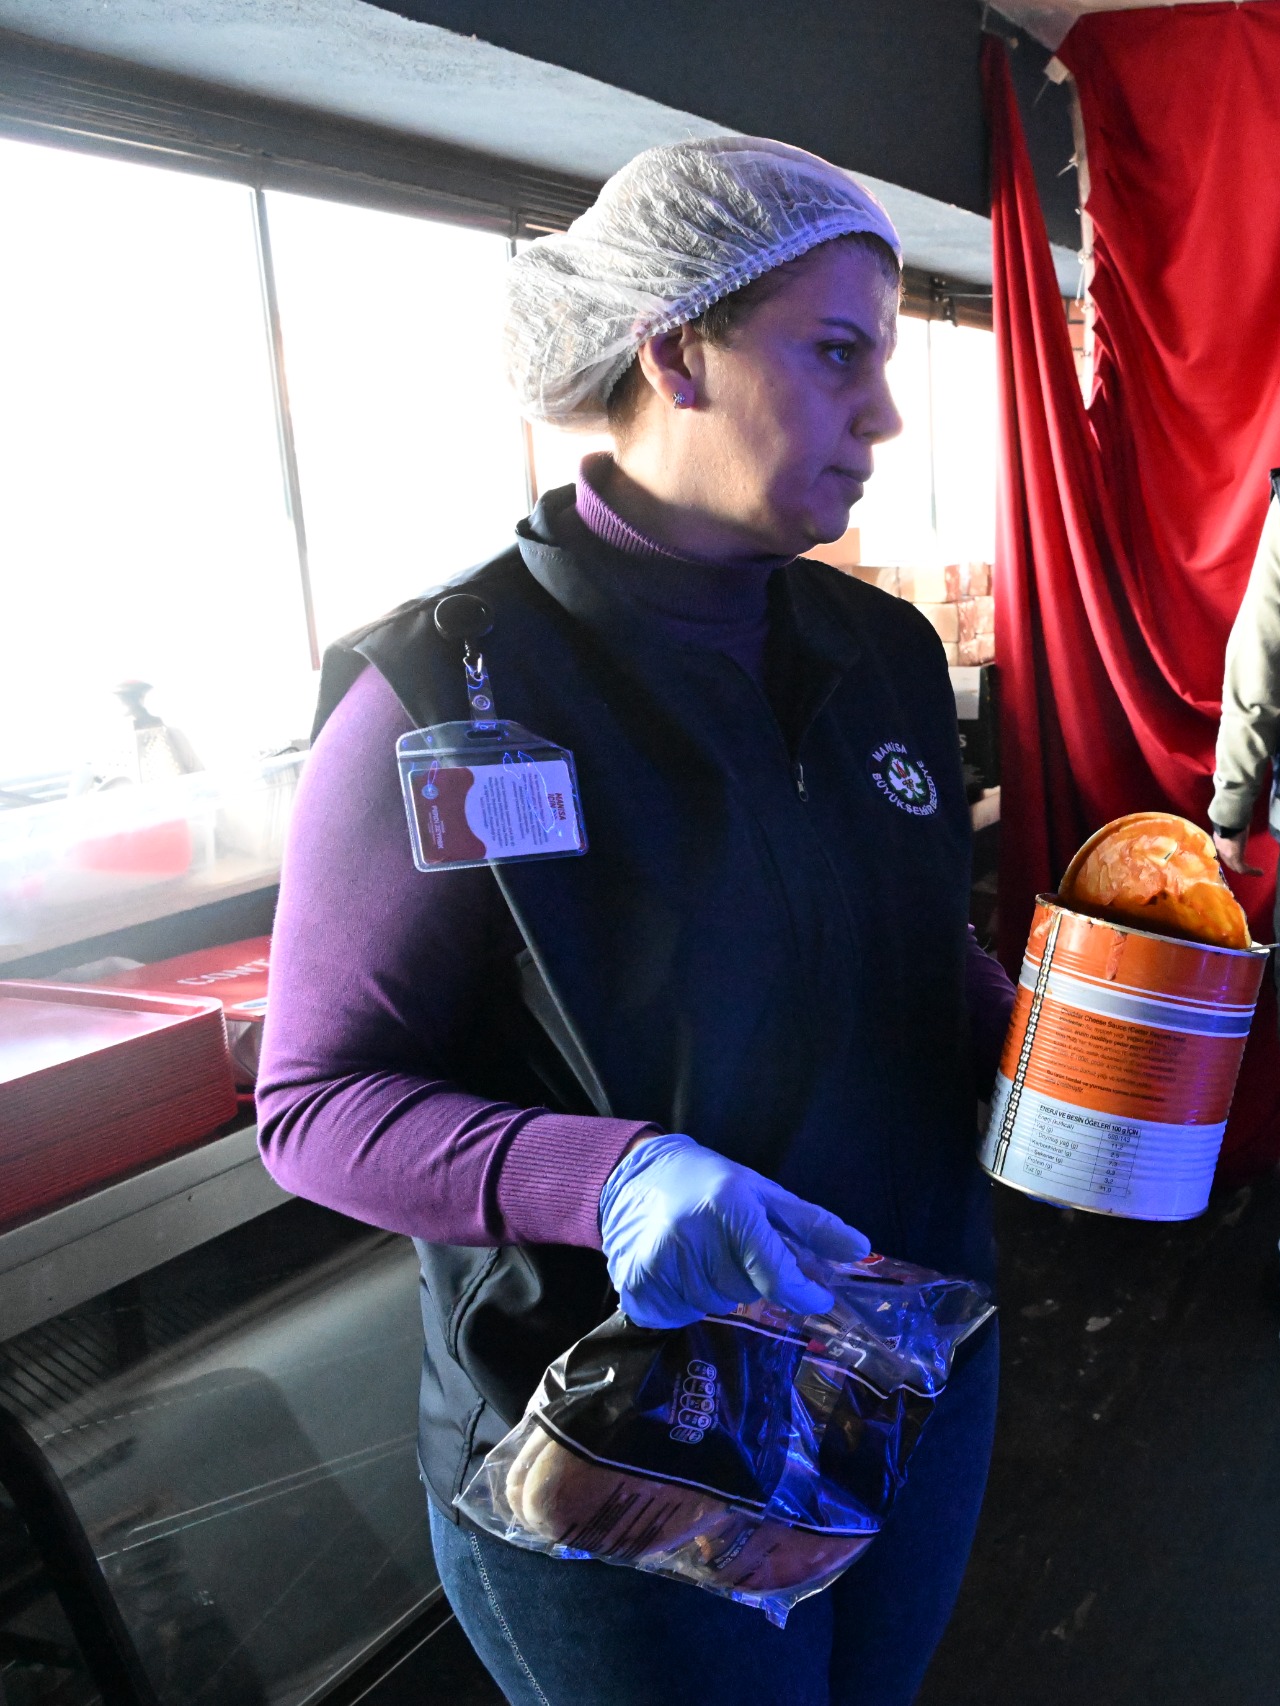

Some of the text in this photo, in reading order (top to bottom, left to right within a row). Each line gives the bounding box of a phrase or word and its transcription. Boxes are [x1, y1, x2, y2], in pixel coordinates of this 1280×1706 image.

[871, 741, 908, 762] MANİSA
[1107, 1021, 1128, 1032] Sauce
[1058, 1111, 1066, 1119] VE
[1111, 1124, 1122, 1133] 100
